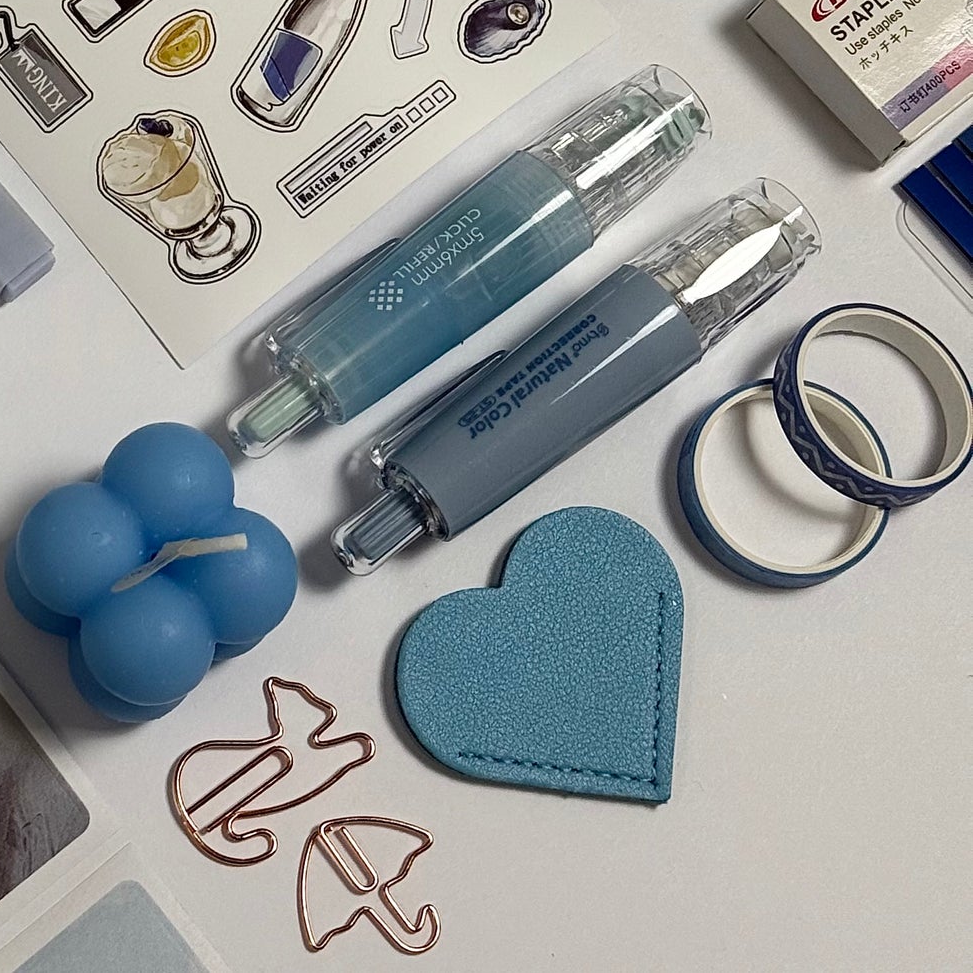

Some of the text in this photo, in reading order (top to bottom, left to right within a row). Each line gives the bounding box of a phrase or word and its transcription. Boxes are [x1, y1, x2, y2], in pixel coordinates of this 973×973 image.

[844, 35, 869, 57] Use
[867, 9, 904, 45] staples
[858, 24, 914, 70] ホッチキス
[27, 66, 67, 112] KING
[298, 121, 403, 205] Waiting for power on
[411, 226, 485, 286] 5mx6mm
[525, 314, 596, 376] CORRECTION
[498, 371, 526, 397] TAPE
[514, 352, 573, 409] Natural
[470, 402, 512, 439] Color
